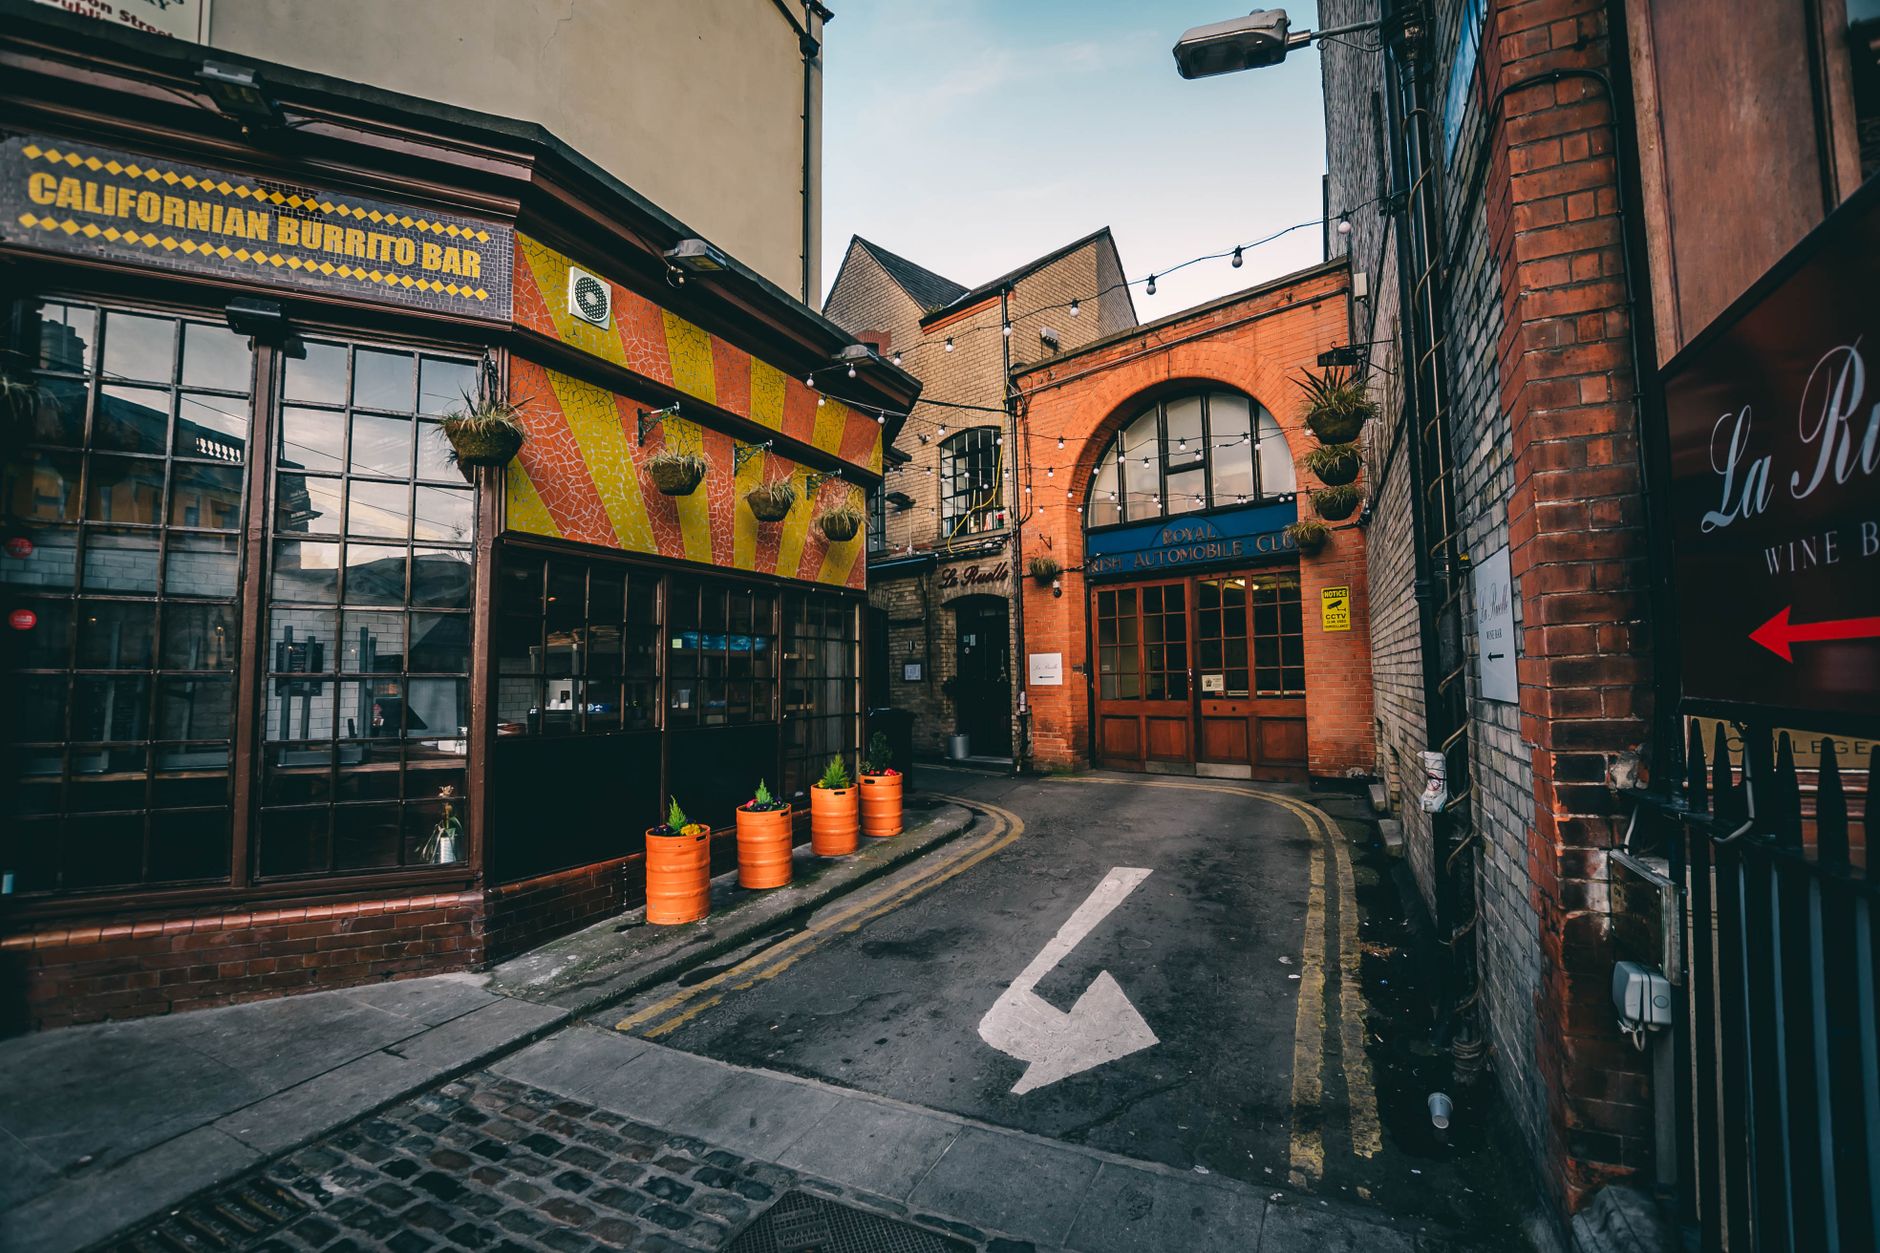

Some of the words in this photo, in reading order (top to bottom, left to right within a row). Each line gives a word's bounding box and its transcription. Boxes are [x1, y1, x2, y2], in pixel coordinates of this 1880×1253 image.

[28, 172, 269, 241] CALIFORNIAN
[277, 215, 415, 266] BURRITO
[422, 241, 481, 279] BAR
[1701, 404, 1774, 533] La
[1134, 540, 1243, 568] AUTOMOBILE
[1256, 531, 1298, 553] CLU
[1162, 523, 1216, 545] ROYAL
[1765, 531, 1839, 576] WINE
[960, 561, 1009, 586] Ruelle
[1726, 737, 1870, 755] CLEGE
